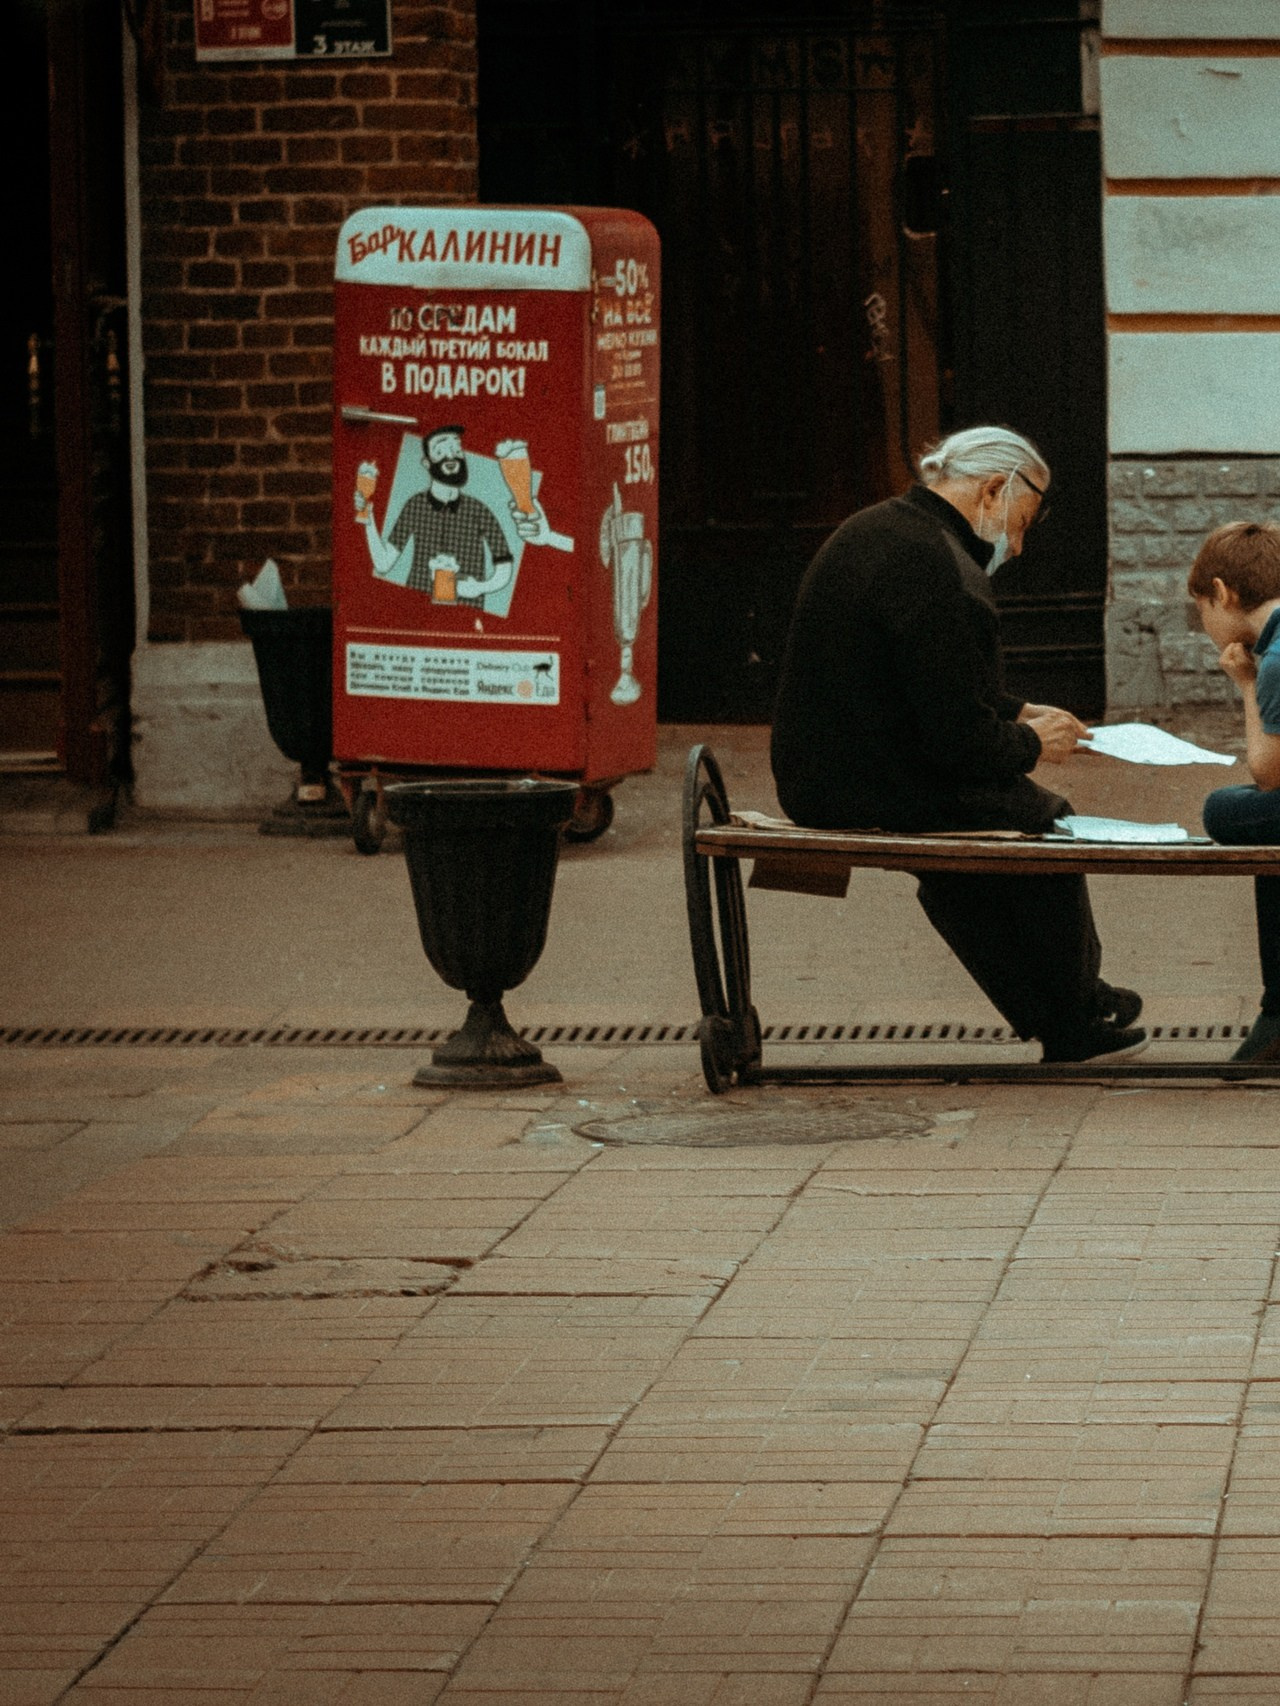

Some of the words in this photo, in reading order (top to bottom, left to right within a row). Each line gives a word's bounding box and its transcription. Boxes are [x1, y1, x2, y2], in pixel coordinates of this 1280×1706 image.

[313, 35, 327, 54] 3
[347, 223, 402, 267] Бар
[397, 228, 562, 268] КАЛИНИН
[359, 333, 427, 361] КАЖДЫЙ
[430, 334, 491, 361] ТРЕТИЙ
[496, 340, 549, 362] БОКАЛ
[381, 362, 397, 394] В
[404, 362, 526, 399] ПОДАРОК!
